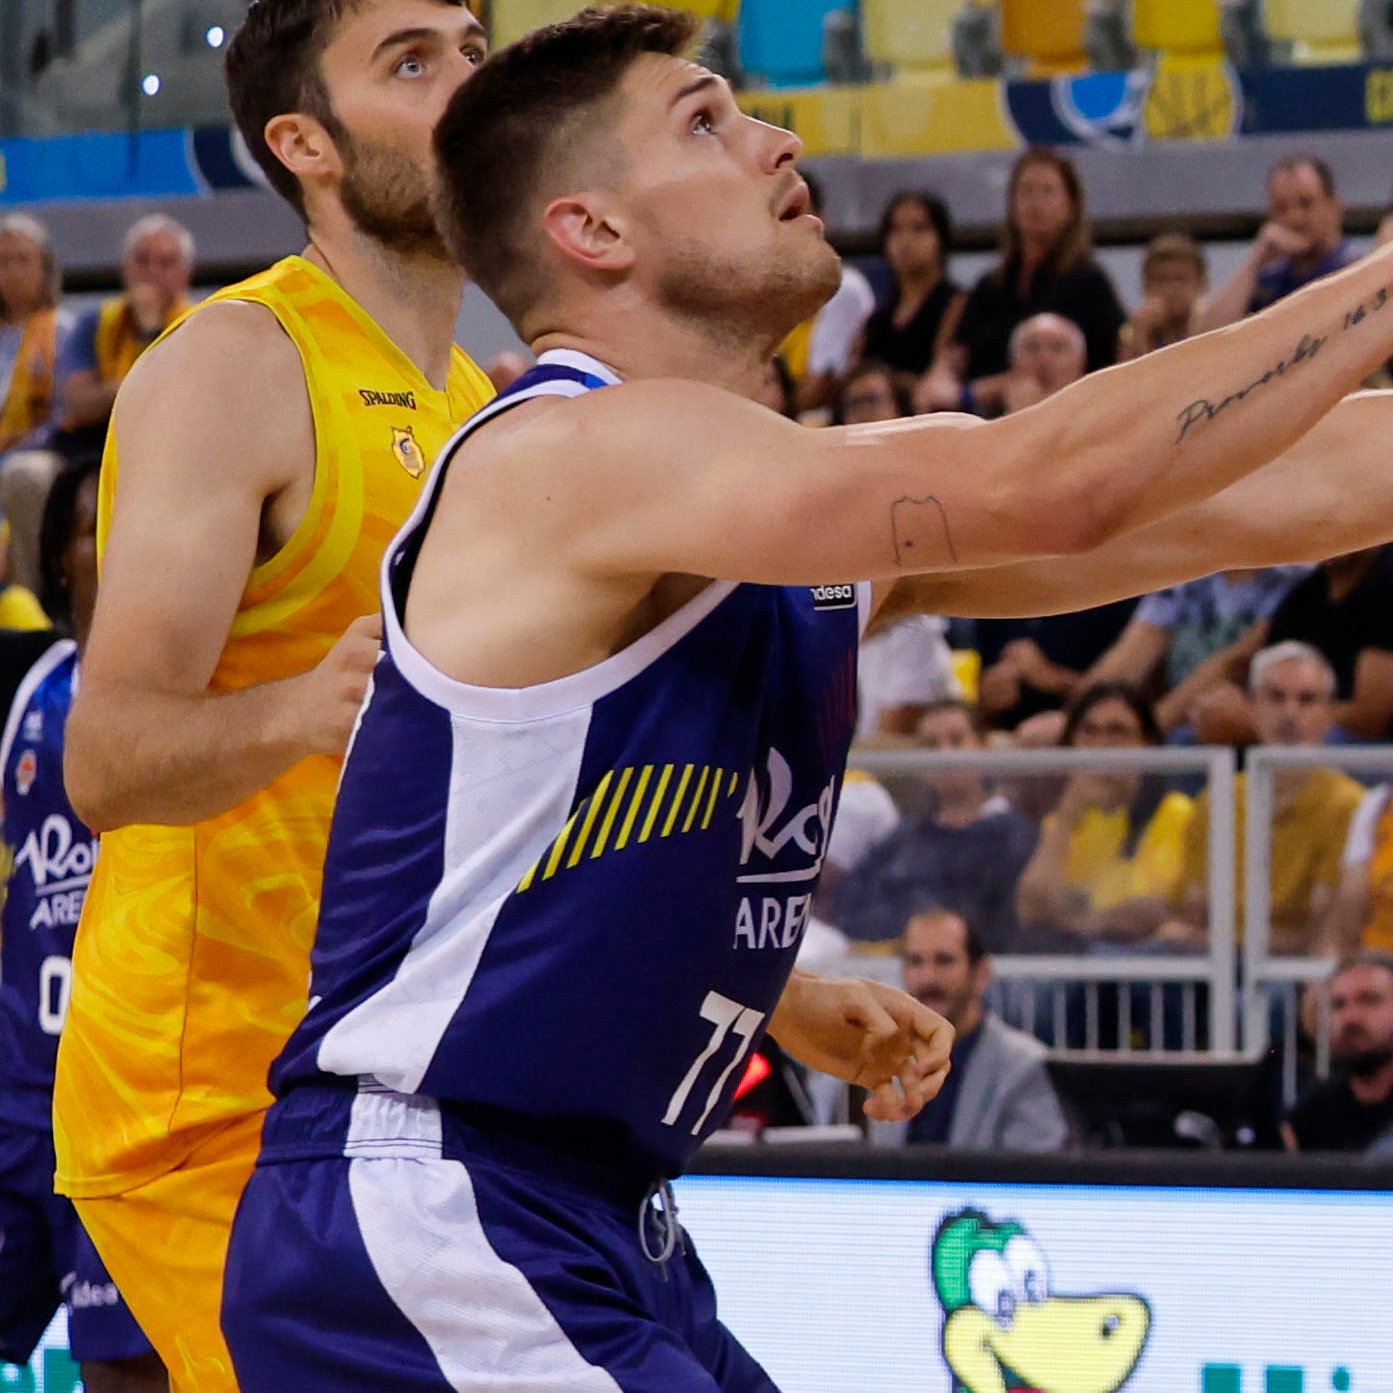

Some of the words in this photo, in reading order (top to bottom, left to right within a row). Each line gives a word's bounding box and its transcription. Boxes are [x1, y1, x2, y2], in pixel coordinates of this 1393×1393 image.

[358, 389, 417, 411] SPALDING
[30, 893, 86, 931] ARE
[39, 954, 72, 1036] 0
[661, 990, 766, 1137] 77
